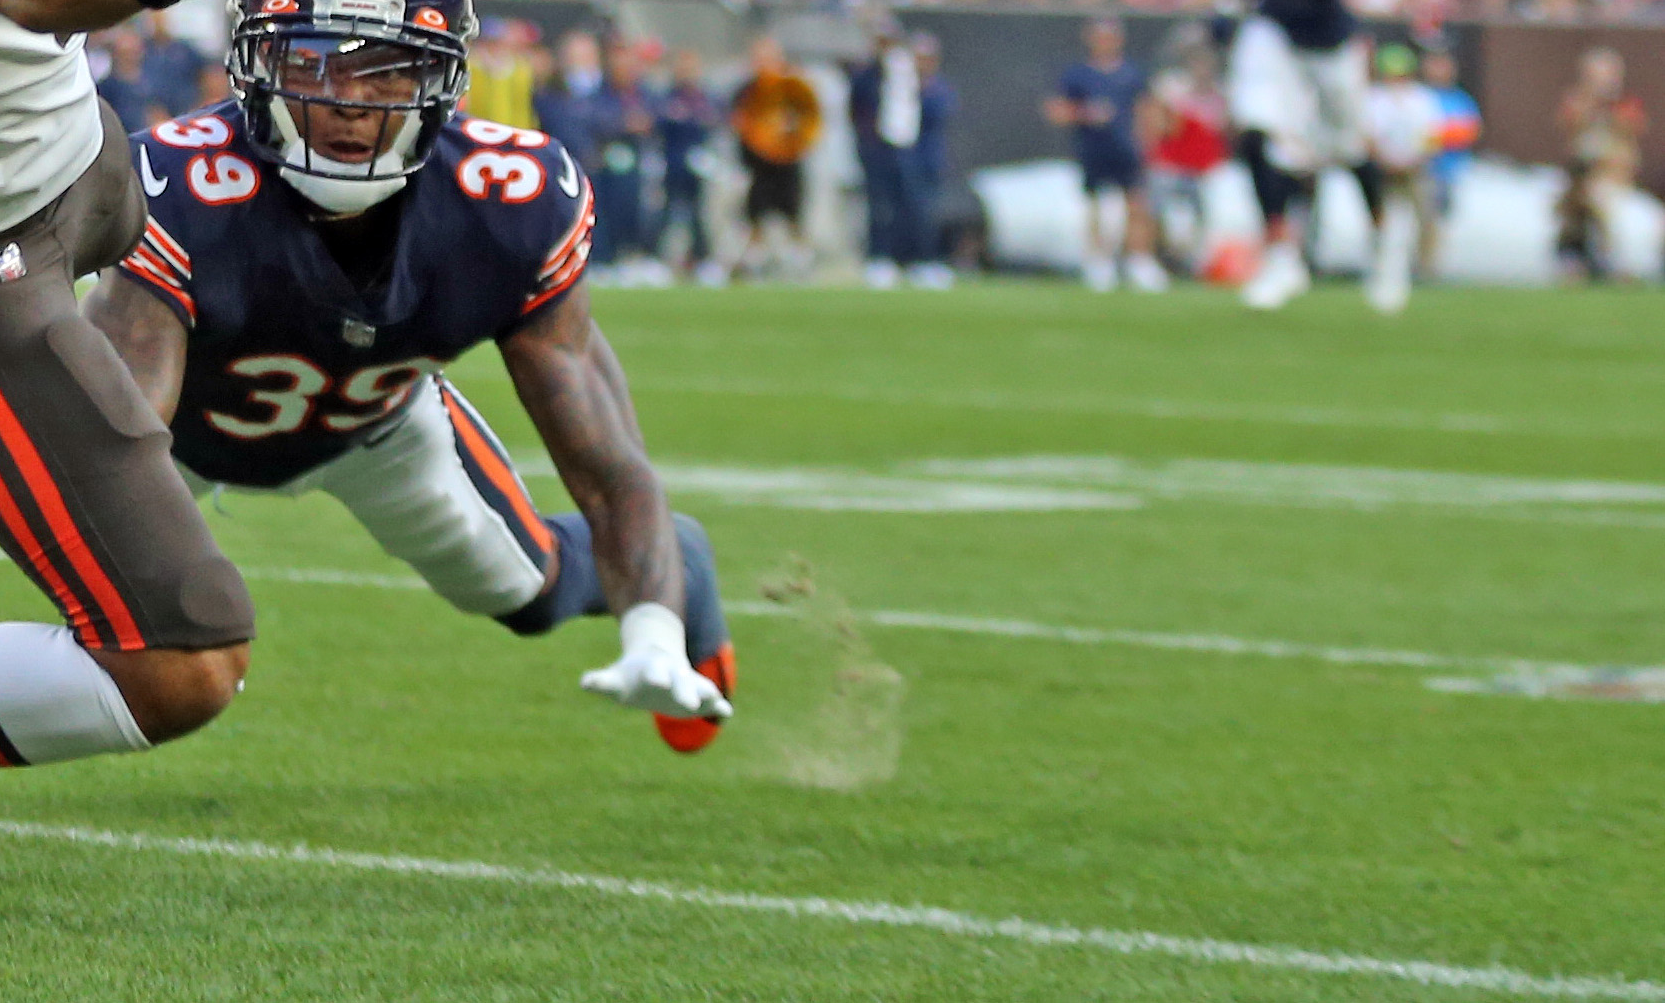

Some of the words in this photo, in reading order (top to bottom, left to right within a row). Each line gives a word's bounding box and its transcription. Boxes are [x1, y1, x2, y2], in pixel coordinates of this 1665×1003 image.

[151, 114, 262, 206] 39
[456, 117, 551, 204] 39
[203, 352, 439, 440] 39
